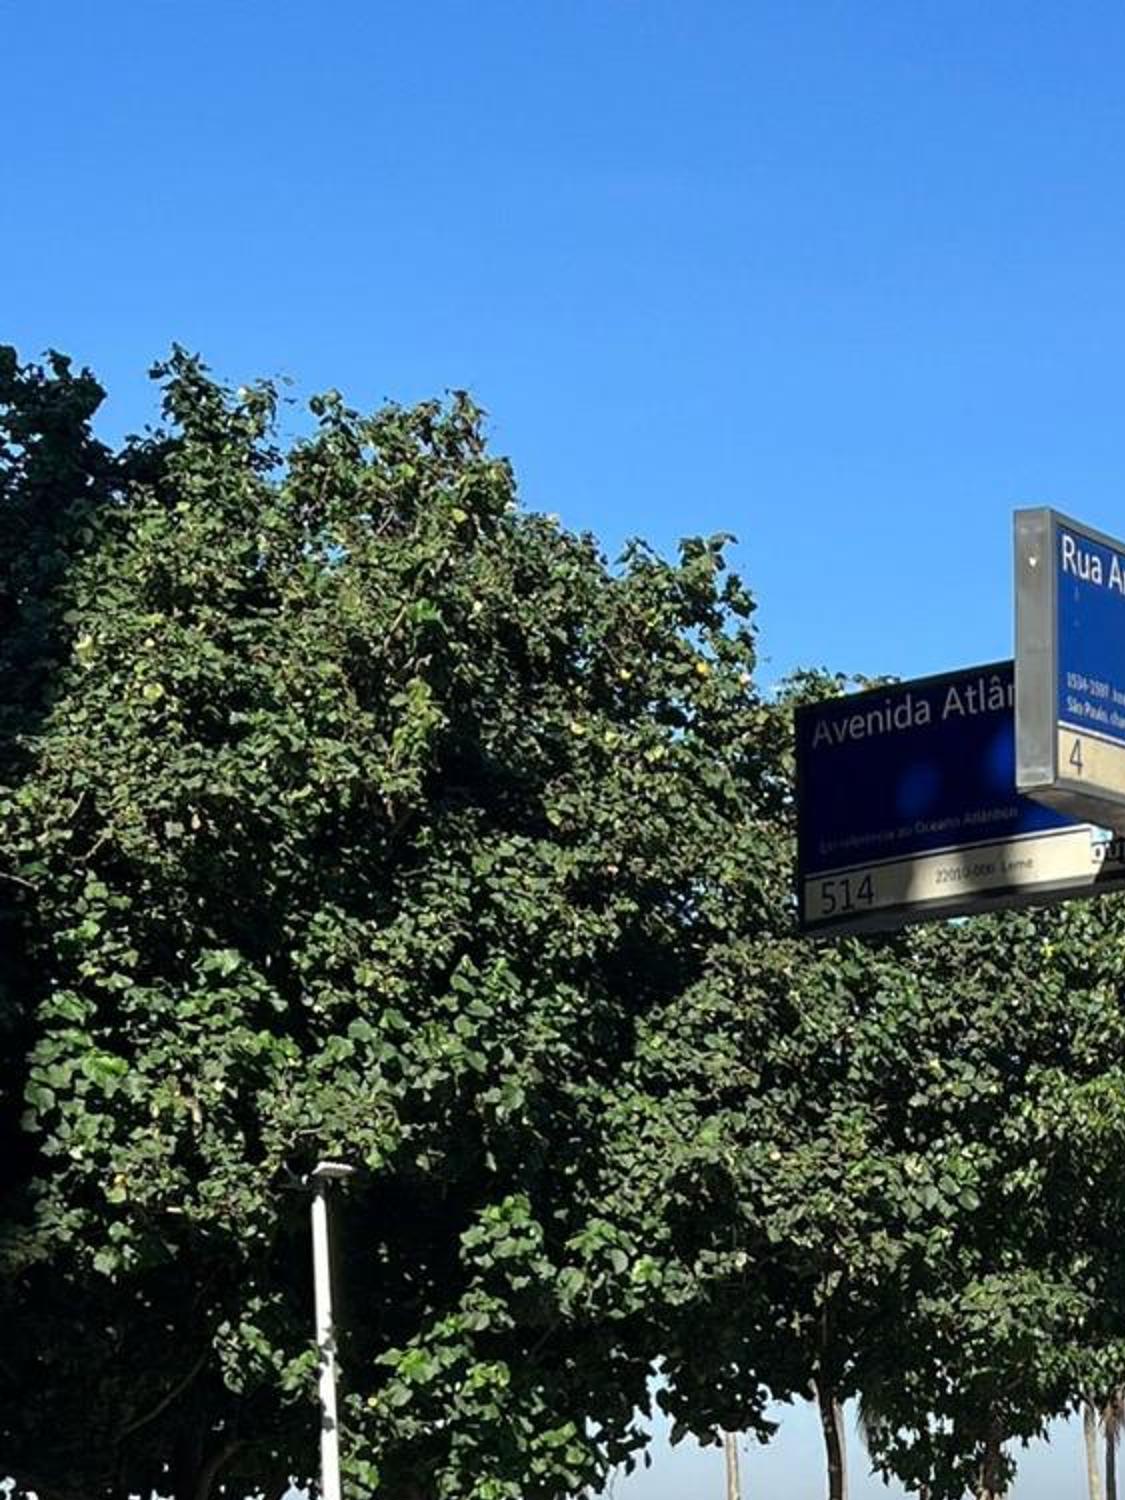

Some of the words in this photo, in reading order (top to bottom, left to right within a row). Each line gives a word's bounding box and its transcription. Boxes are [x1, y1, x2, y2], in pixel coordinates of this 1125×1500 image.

[1061, 533, 1103, 585] Rua
[811, 692, 932, 750] Avenida
[1069, 737, 1083, 776] 4
[821, 873, 875, 915] 514
